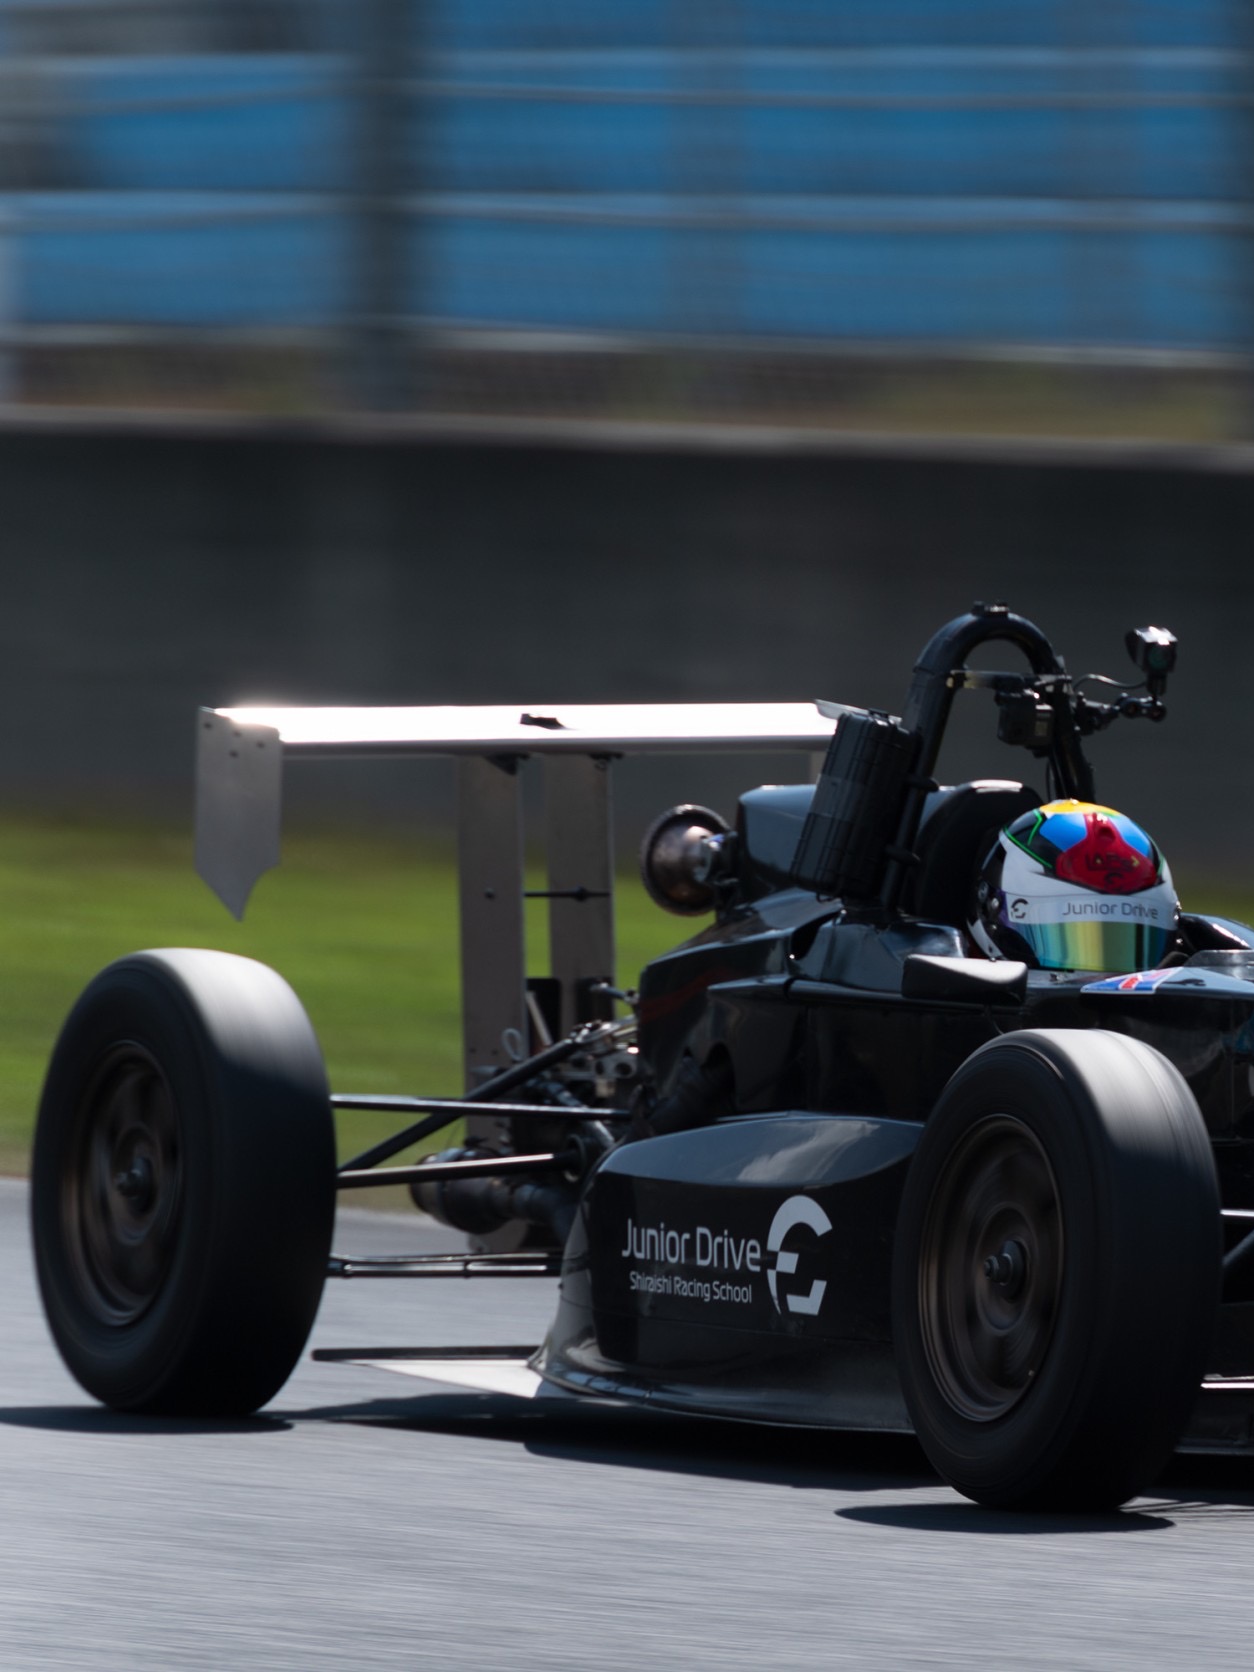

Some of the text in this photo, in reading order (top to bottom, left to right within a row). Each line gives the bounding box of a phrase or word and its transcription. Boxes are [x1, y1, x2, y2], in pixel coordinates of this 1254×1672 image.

[1062, 902, 1159, 920] Junior Drive
[621, 1218, 762, 1272] Junior Drive
[629, 1271, 752, 1304] Shiraishi Racing School
